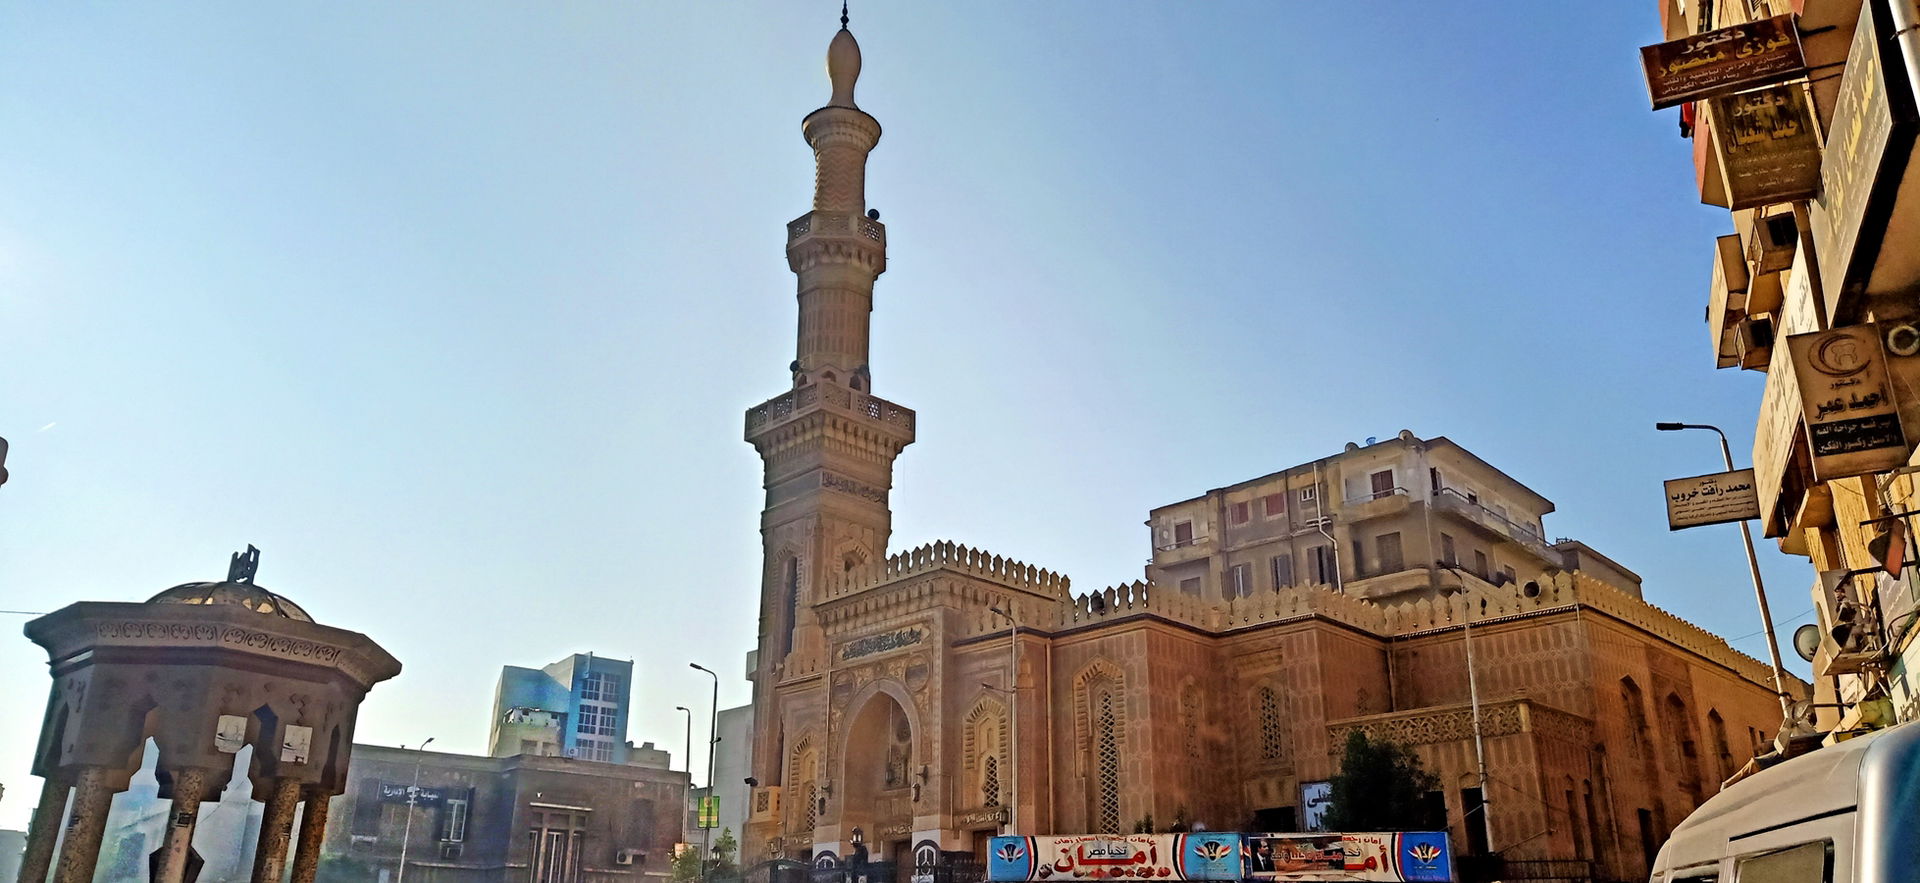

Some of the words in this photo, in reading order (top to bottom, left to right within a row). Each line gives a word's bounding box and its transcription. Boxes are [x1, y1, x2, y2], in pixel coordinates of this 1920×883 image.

[1681, 30, 1746, 54] دكتور
[1657, 50, 1726, 78] منصور
[1735, 96, 1784, 117] دكتور
[1830, 377, 1861, 390] دكتور
[1816, 397, 1846, 421] عمر
[1834, 423, 1857, 435] جراحة
[1818, 440, 1843, 454] الفكين
[1671, 488, 1699, 502] خروب
[1726, 483, 1751, 493] محمد
[1087, 848, 1106, 859] مصر
[1107, 844, 1127, 858] تحيا
